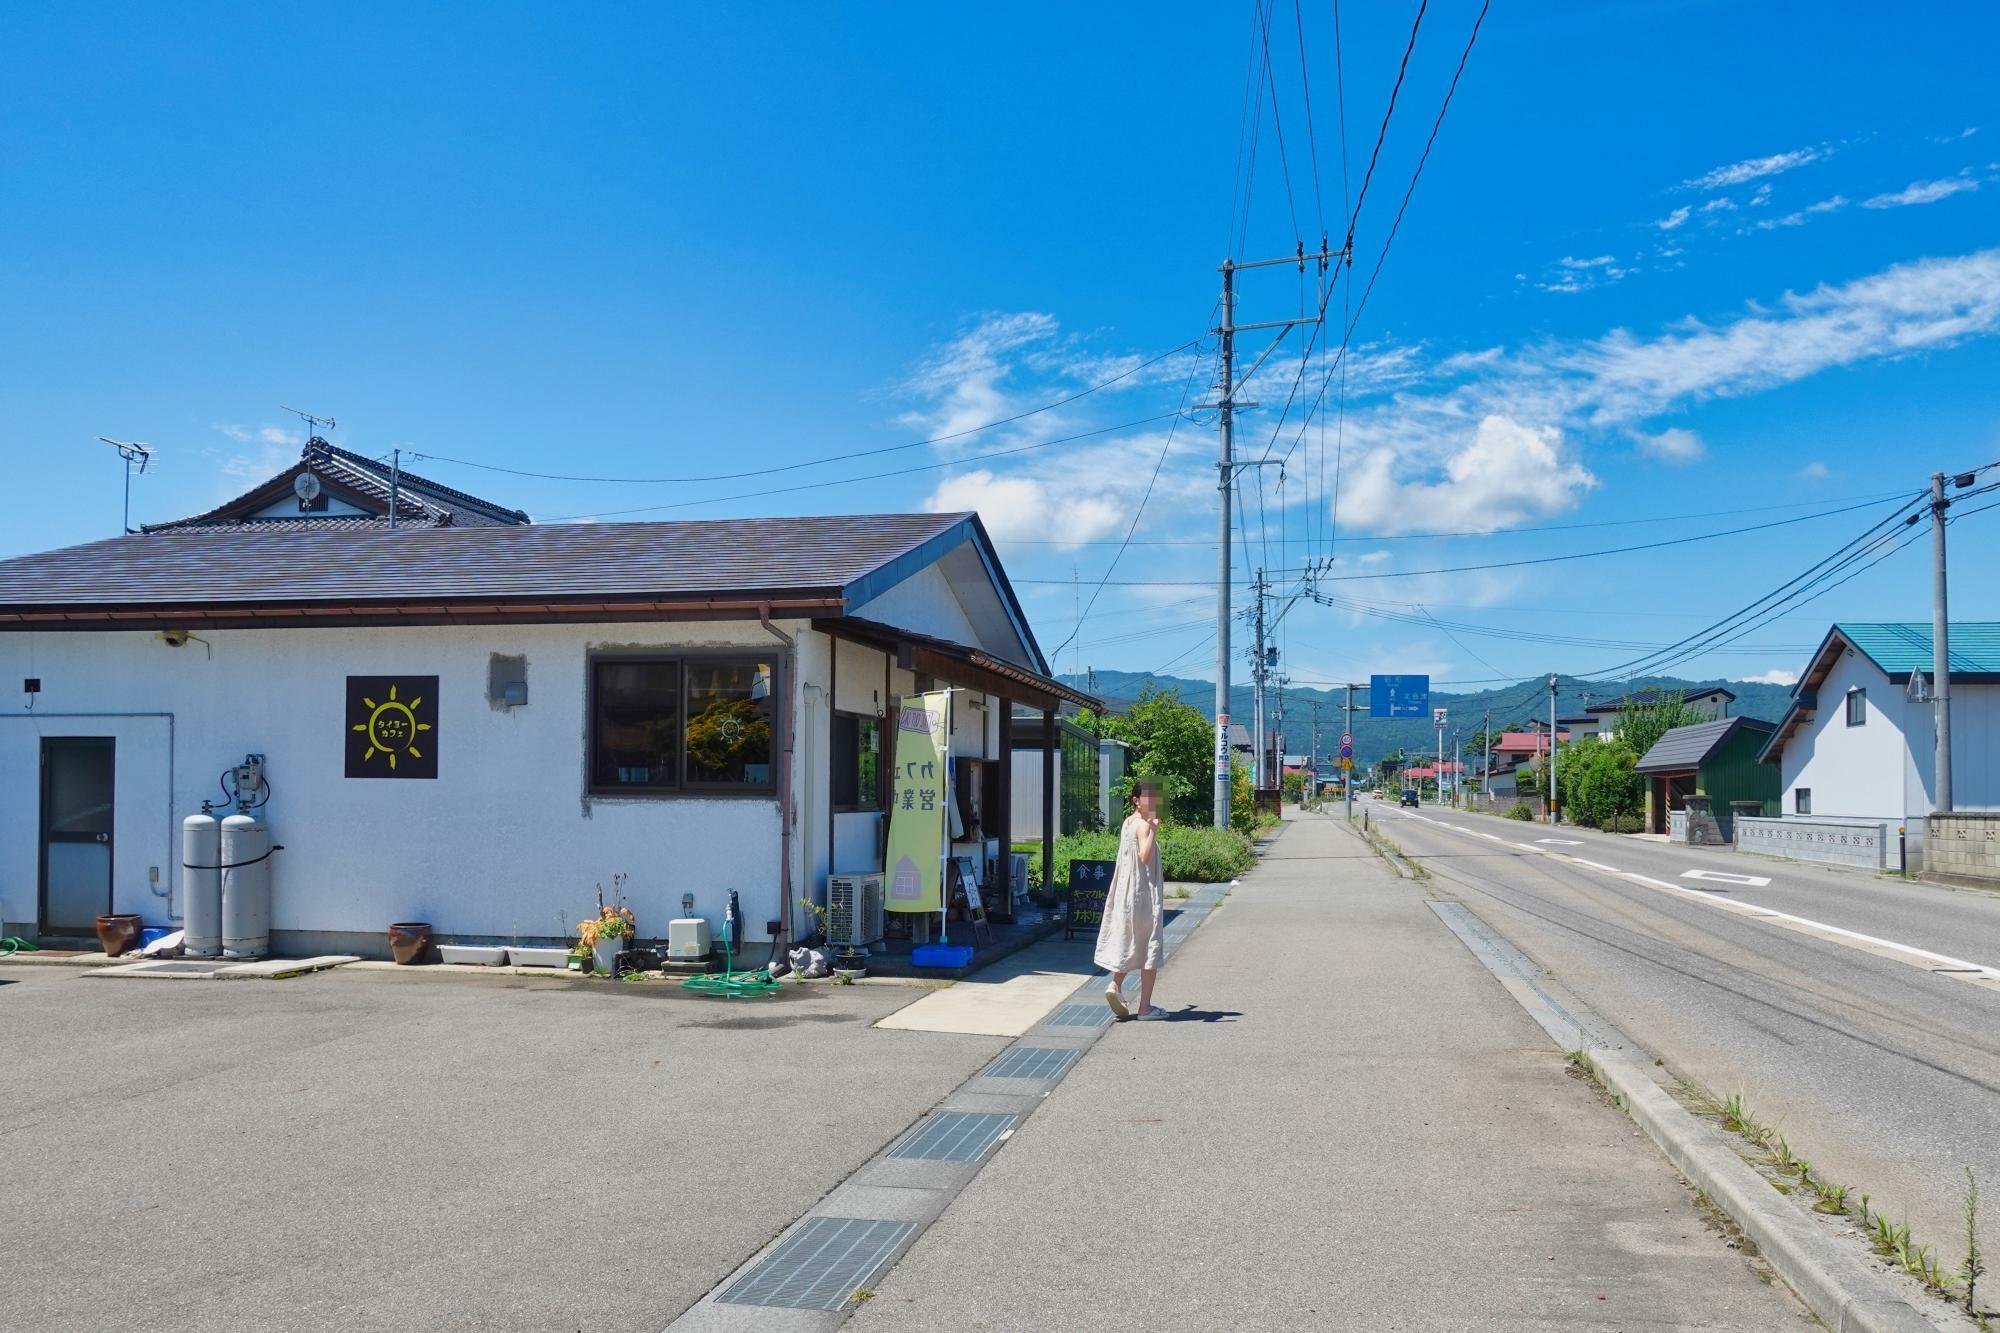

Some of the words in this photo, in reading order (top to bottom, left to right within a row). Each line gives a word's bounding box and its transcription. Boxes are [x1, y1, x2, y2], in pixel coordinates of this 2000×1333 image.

[378, 720, 408, 729] タイヨー
[382, 730, 403, 738] カフェ
[1220, 725, 1229, 754] マルコウ
[1076, 863, 1107, 880] 食事
